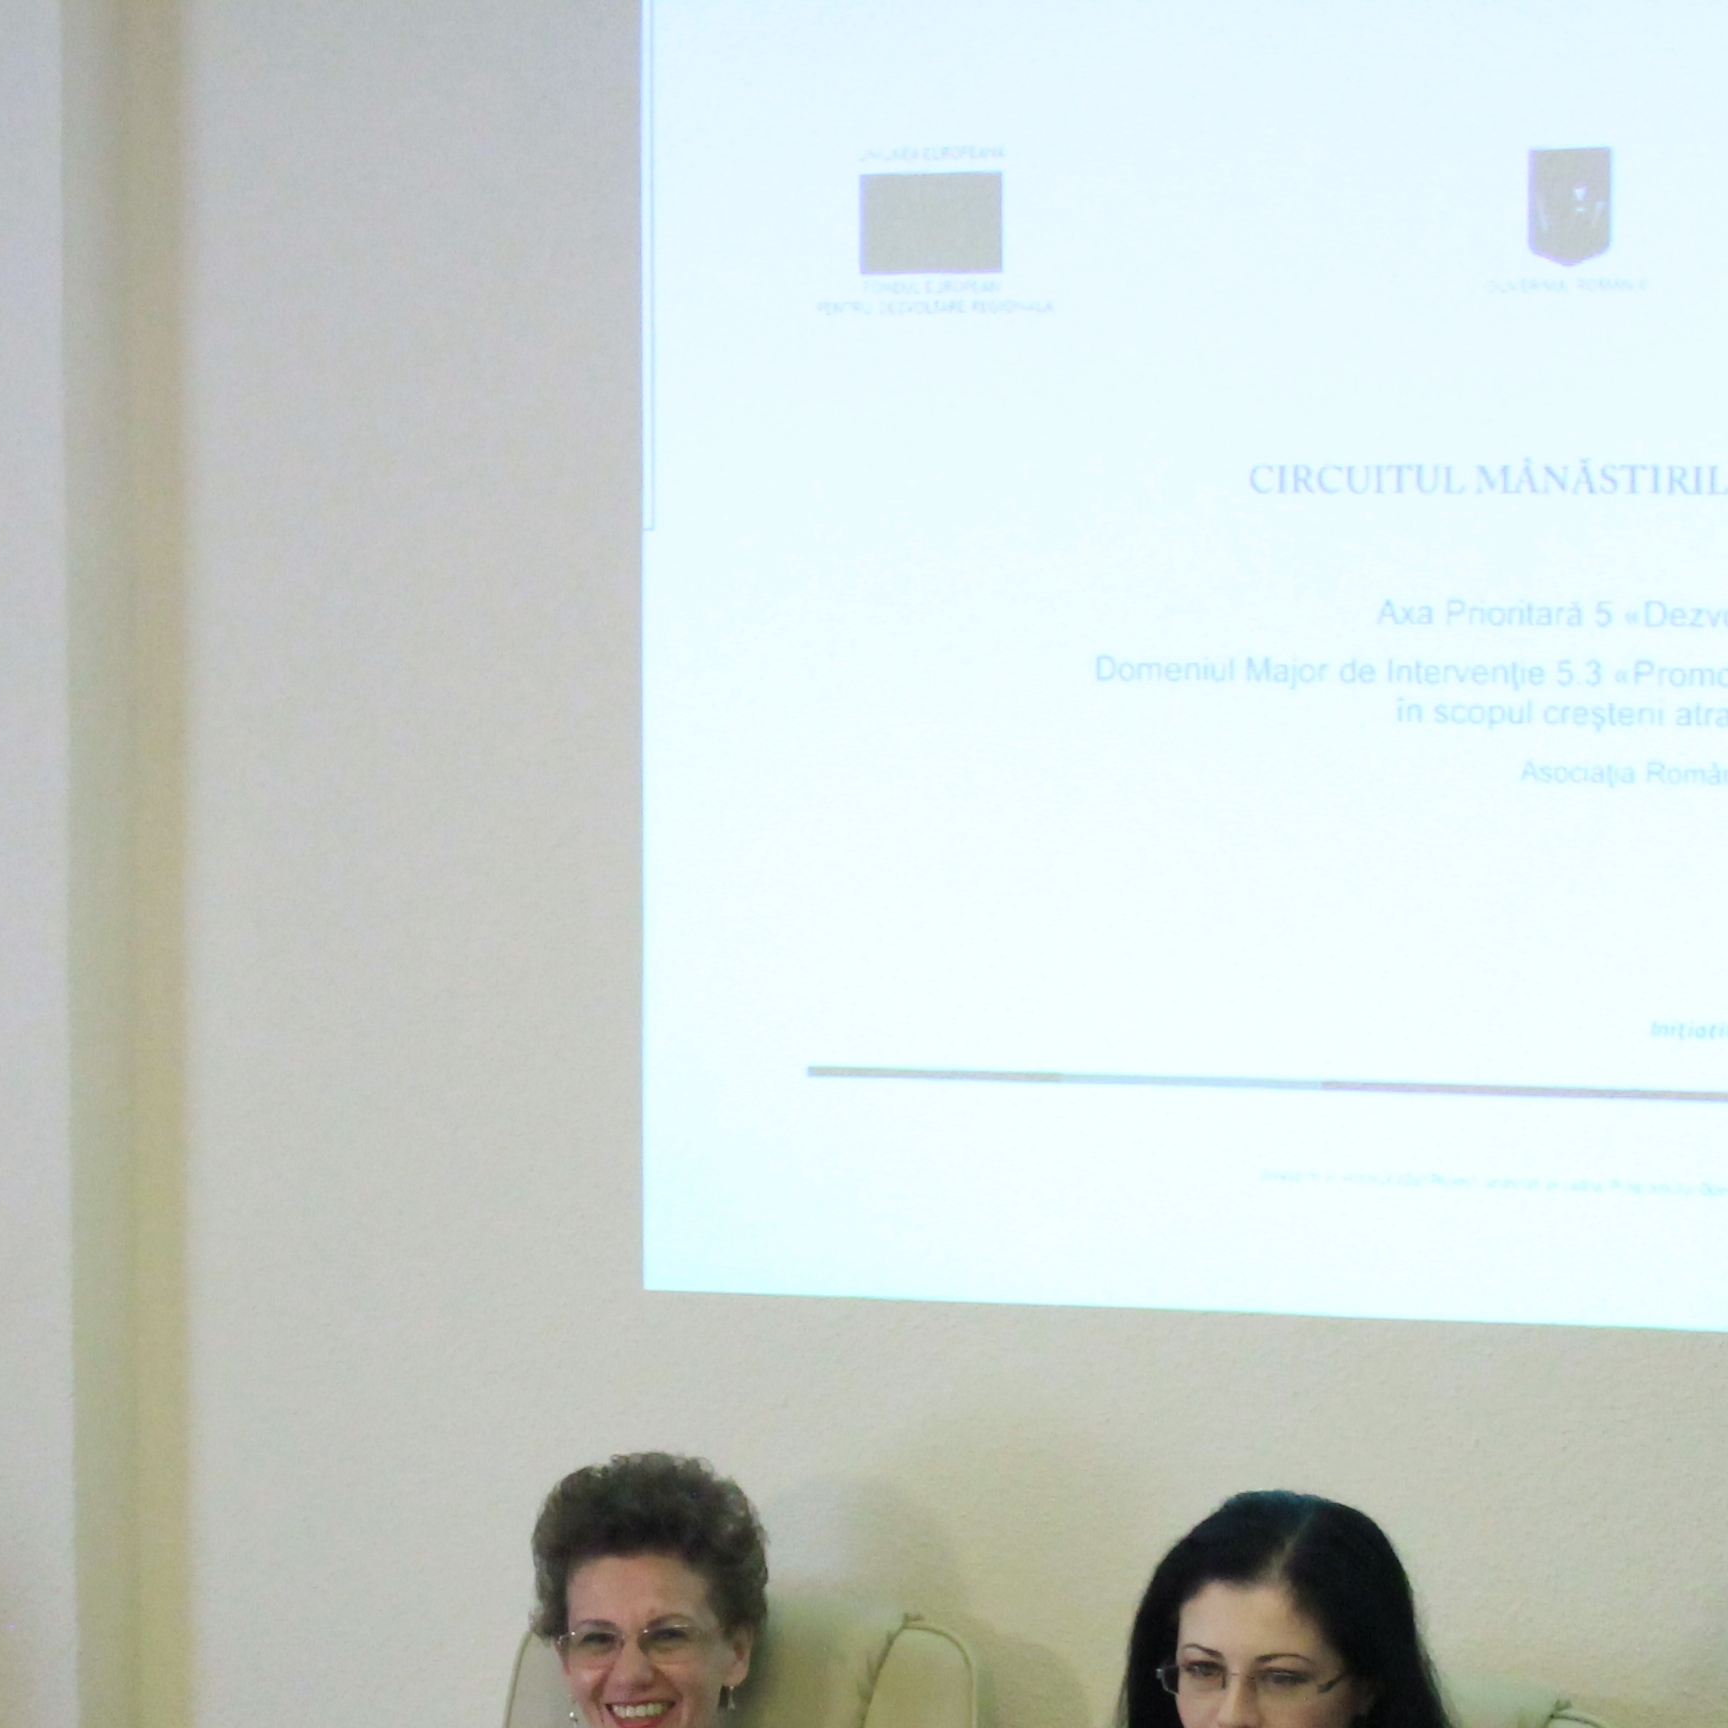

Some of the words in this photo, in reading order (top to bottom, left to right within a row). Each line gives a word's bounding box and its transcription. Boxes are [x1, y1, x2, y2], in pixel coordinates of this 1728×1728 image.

[1249, 462, 1468, 496] CIRCUITUL
[1377, 598, 1434, 627] Axa
[1595, 600, 1615, 629] 5
[1094, 652, 1238, 684] Domeniul
[1244, 655, 1331, 691] Major
[1337, 657, 1378, 685] de
[1433, 698, 1535, 731] scopul
